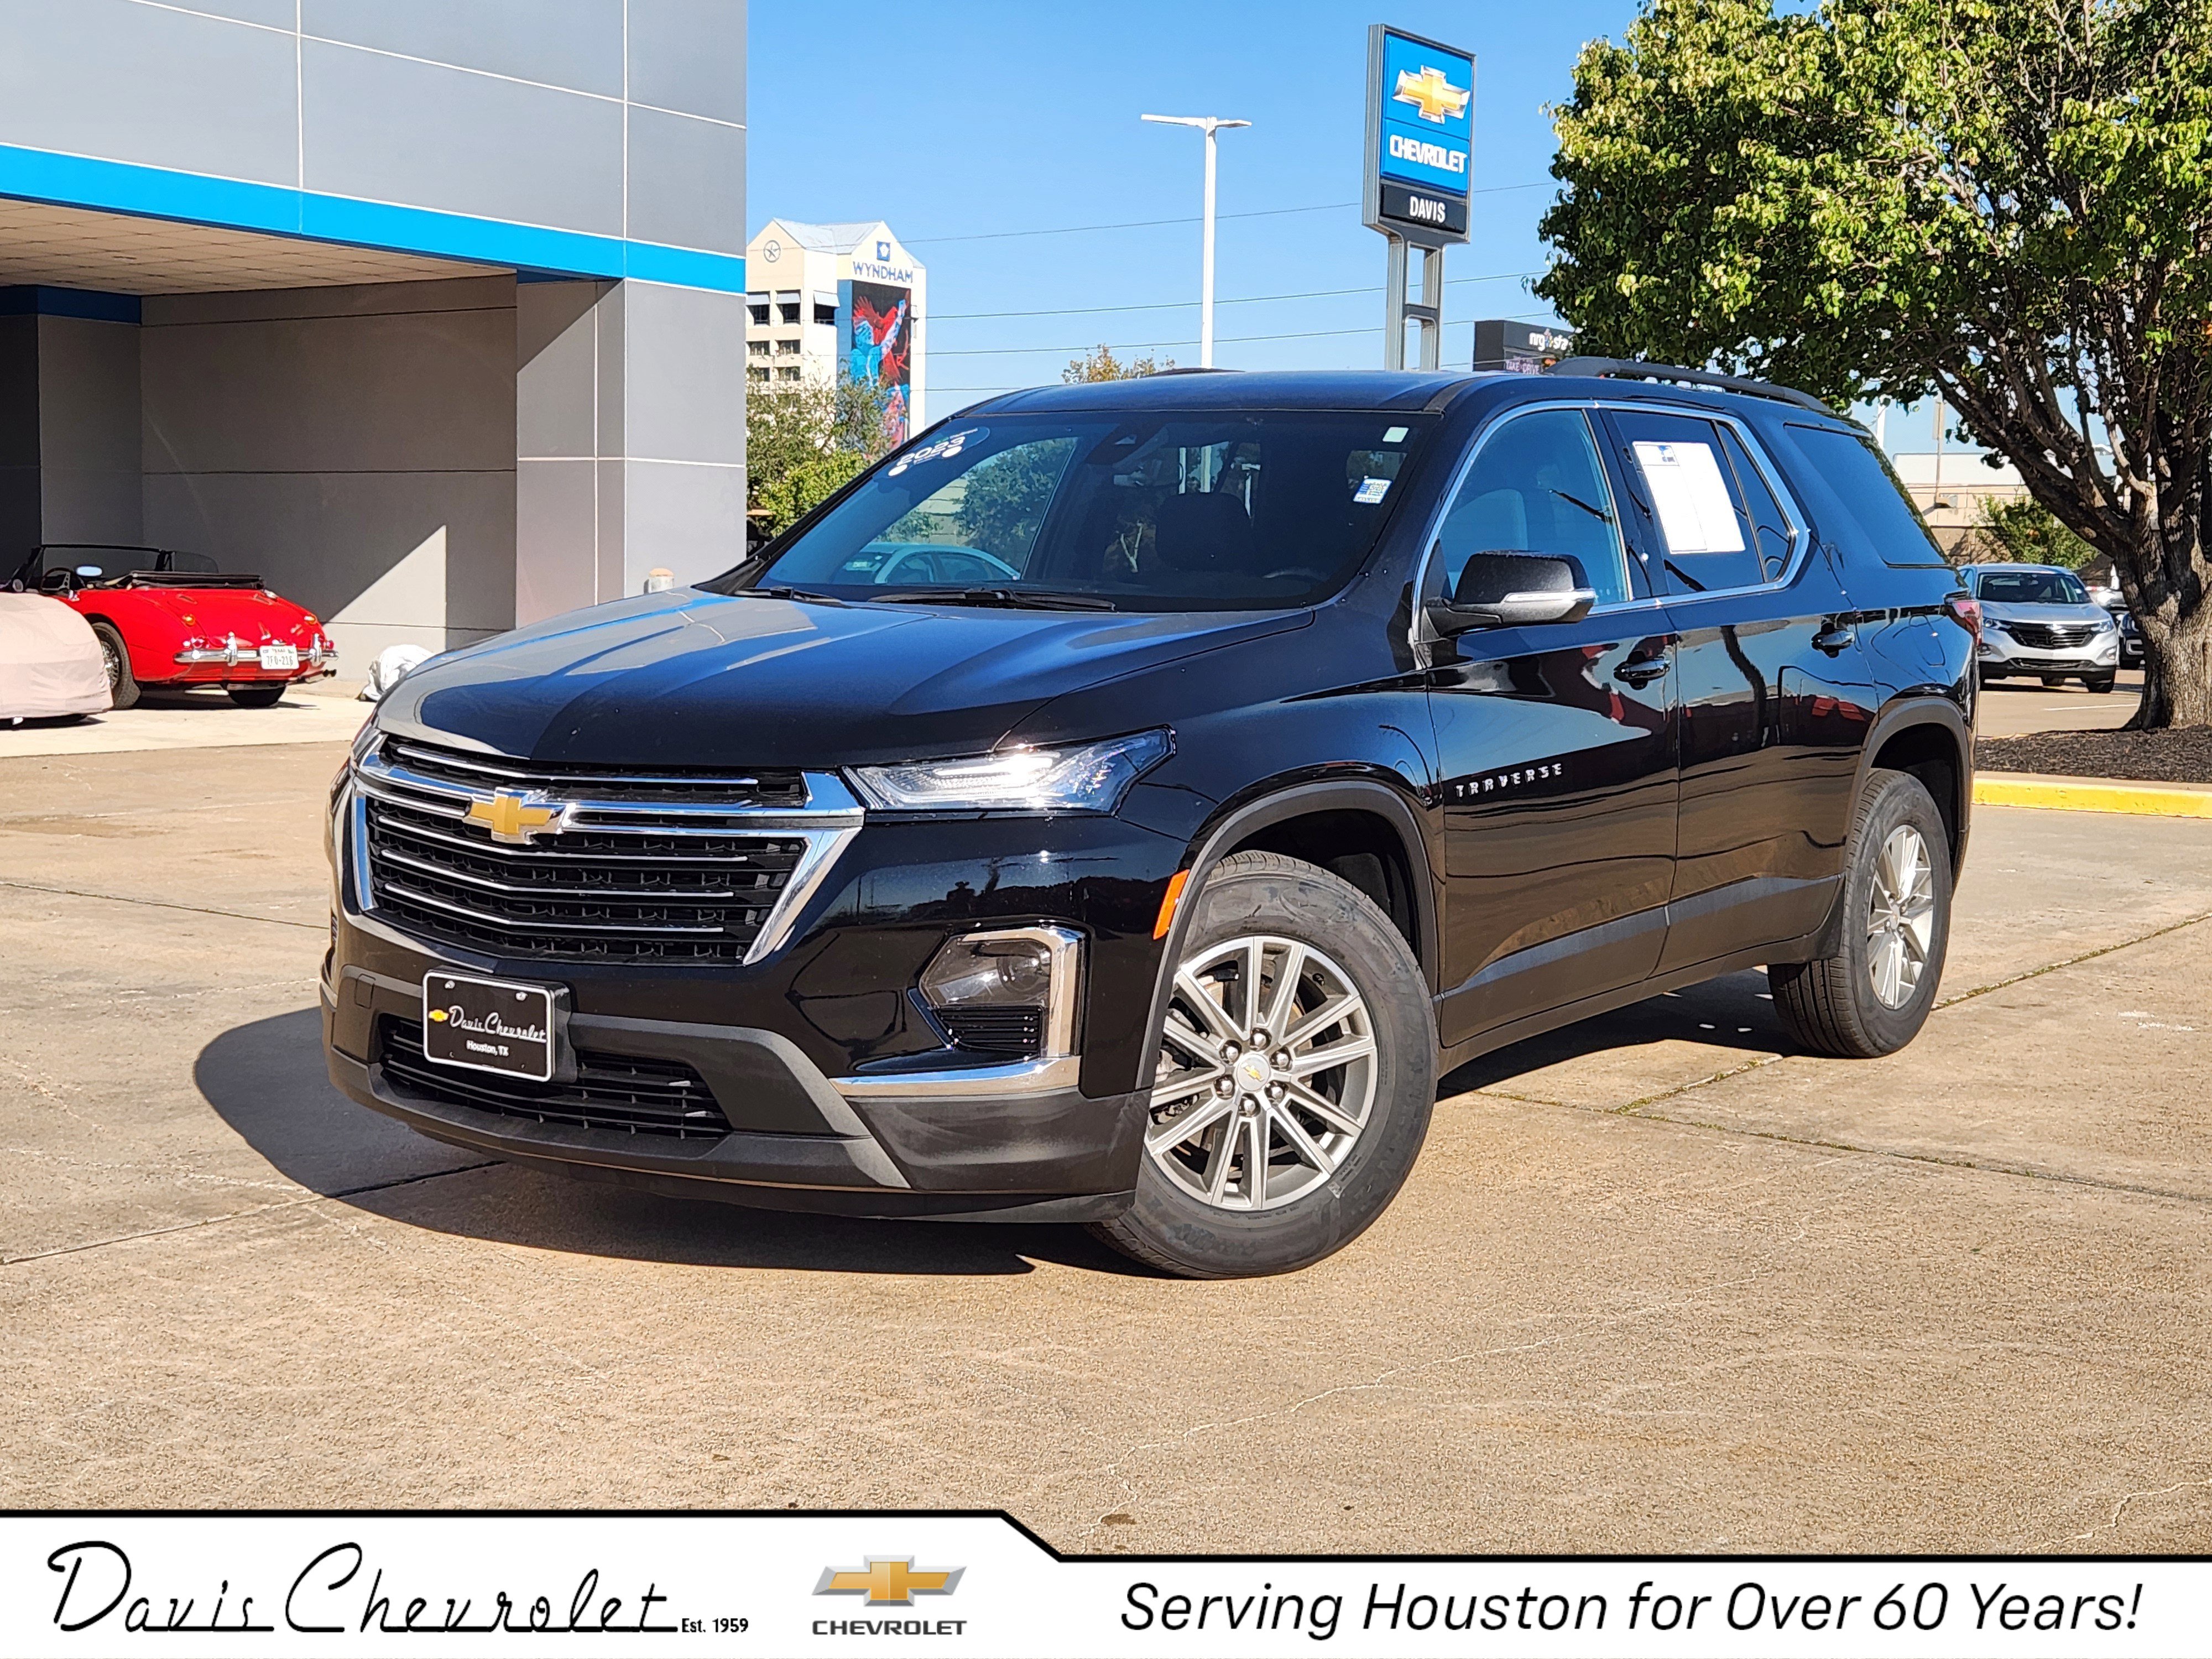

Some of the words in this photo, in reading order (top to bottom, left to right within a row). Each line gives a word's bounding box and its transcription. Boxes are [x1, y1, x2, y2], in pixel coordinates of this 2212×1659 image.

[1390, 134, 1468, 174] CHEVROLET
[1410, 196, 1446, 223] DAVIS
[853, 261, 913, 283] WYNDHAM
[1530, 333, 1545, 351] nrg
[896, 436, 966, 467] 2023
[1454, 763, 1562, 798] TRAVERSE
[448, 1005, 484, 1032] Davis
[484, 1012, 546, 1042] Chevrolet
[466, 1040, 497, 1056] Houston,
[498, 1045, 509, 1056] TX
